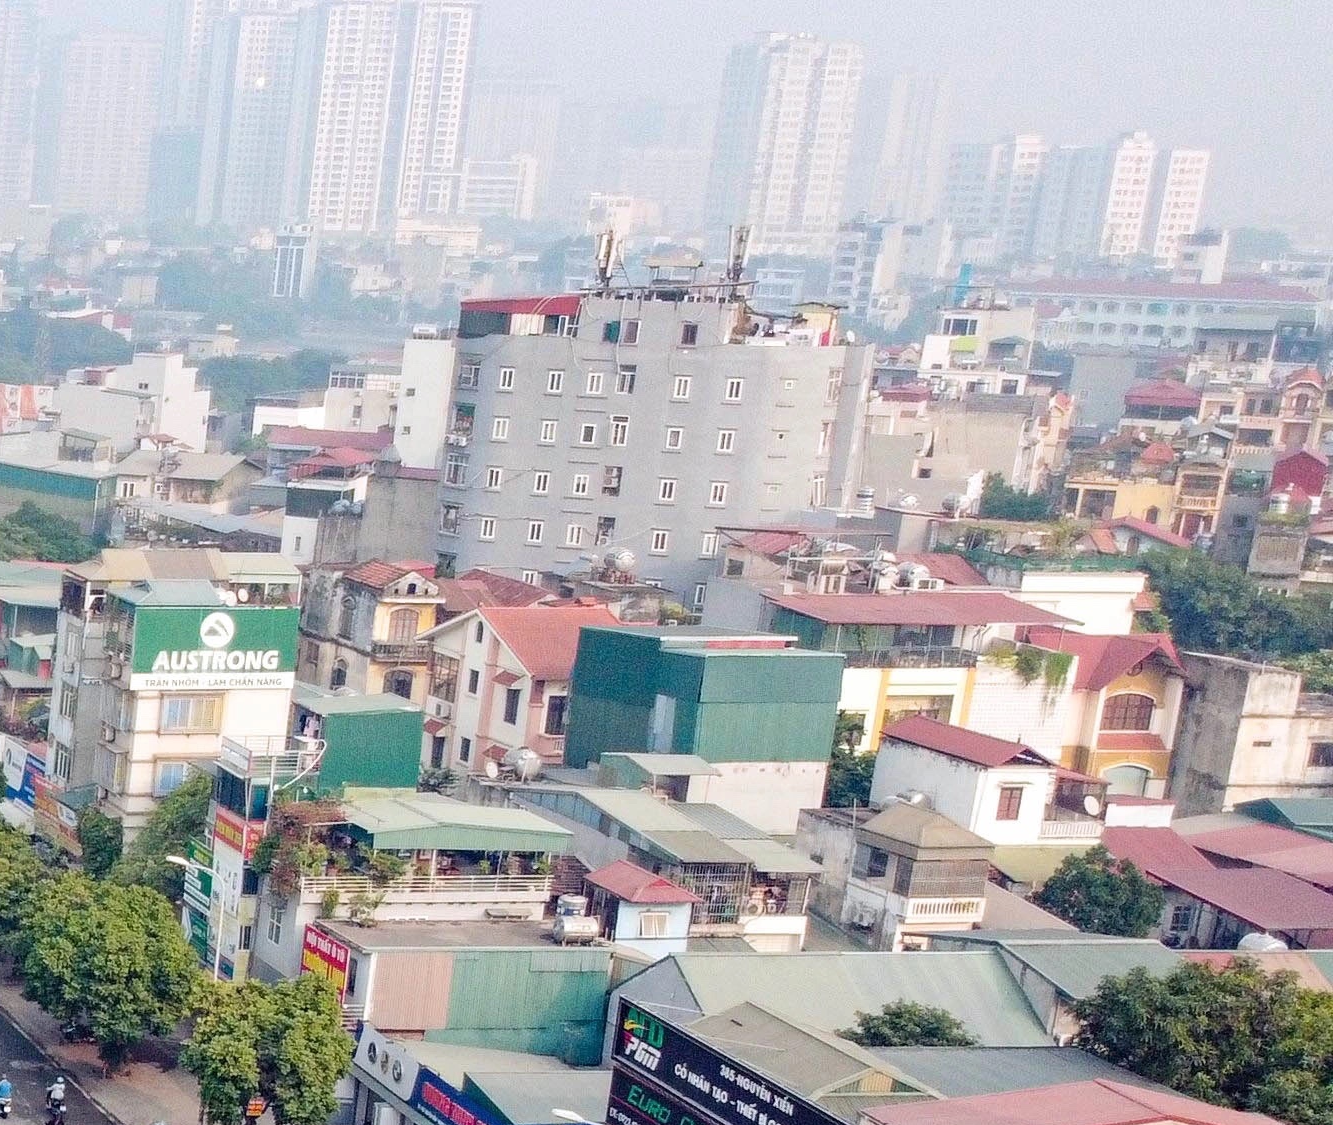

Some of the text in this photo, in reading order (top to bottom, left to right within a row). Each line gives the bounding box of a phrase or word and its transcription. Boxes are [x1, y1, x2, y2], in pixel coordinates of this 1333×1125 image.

[151, 650, 278, 671] AUSTRONG
[627, 1084, 671, 1123] EURO
[687, 1069, 710, 1094] NHÂN
[712, 1086, 728, 1104] TẠO
